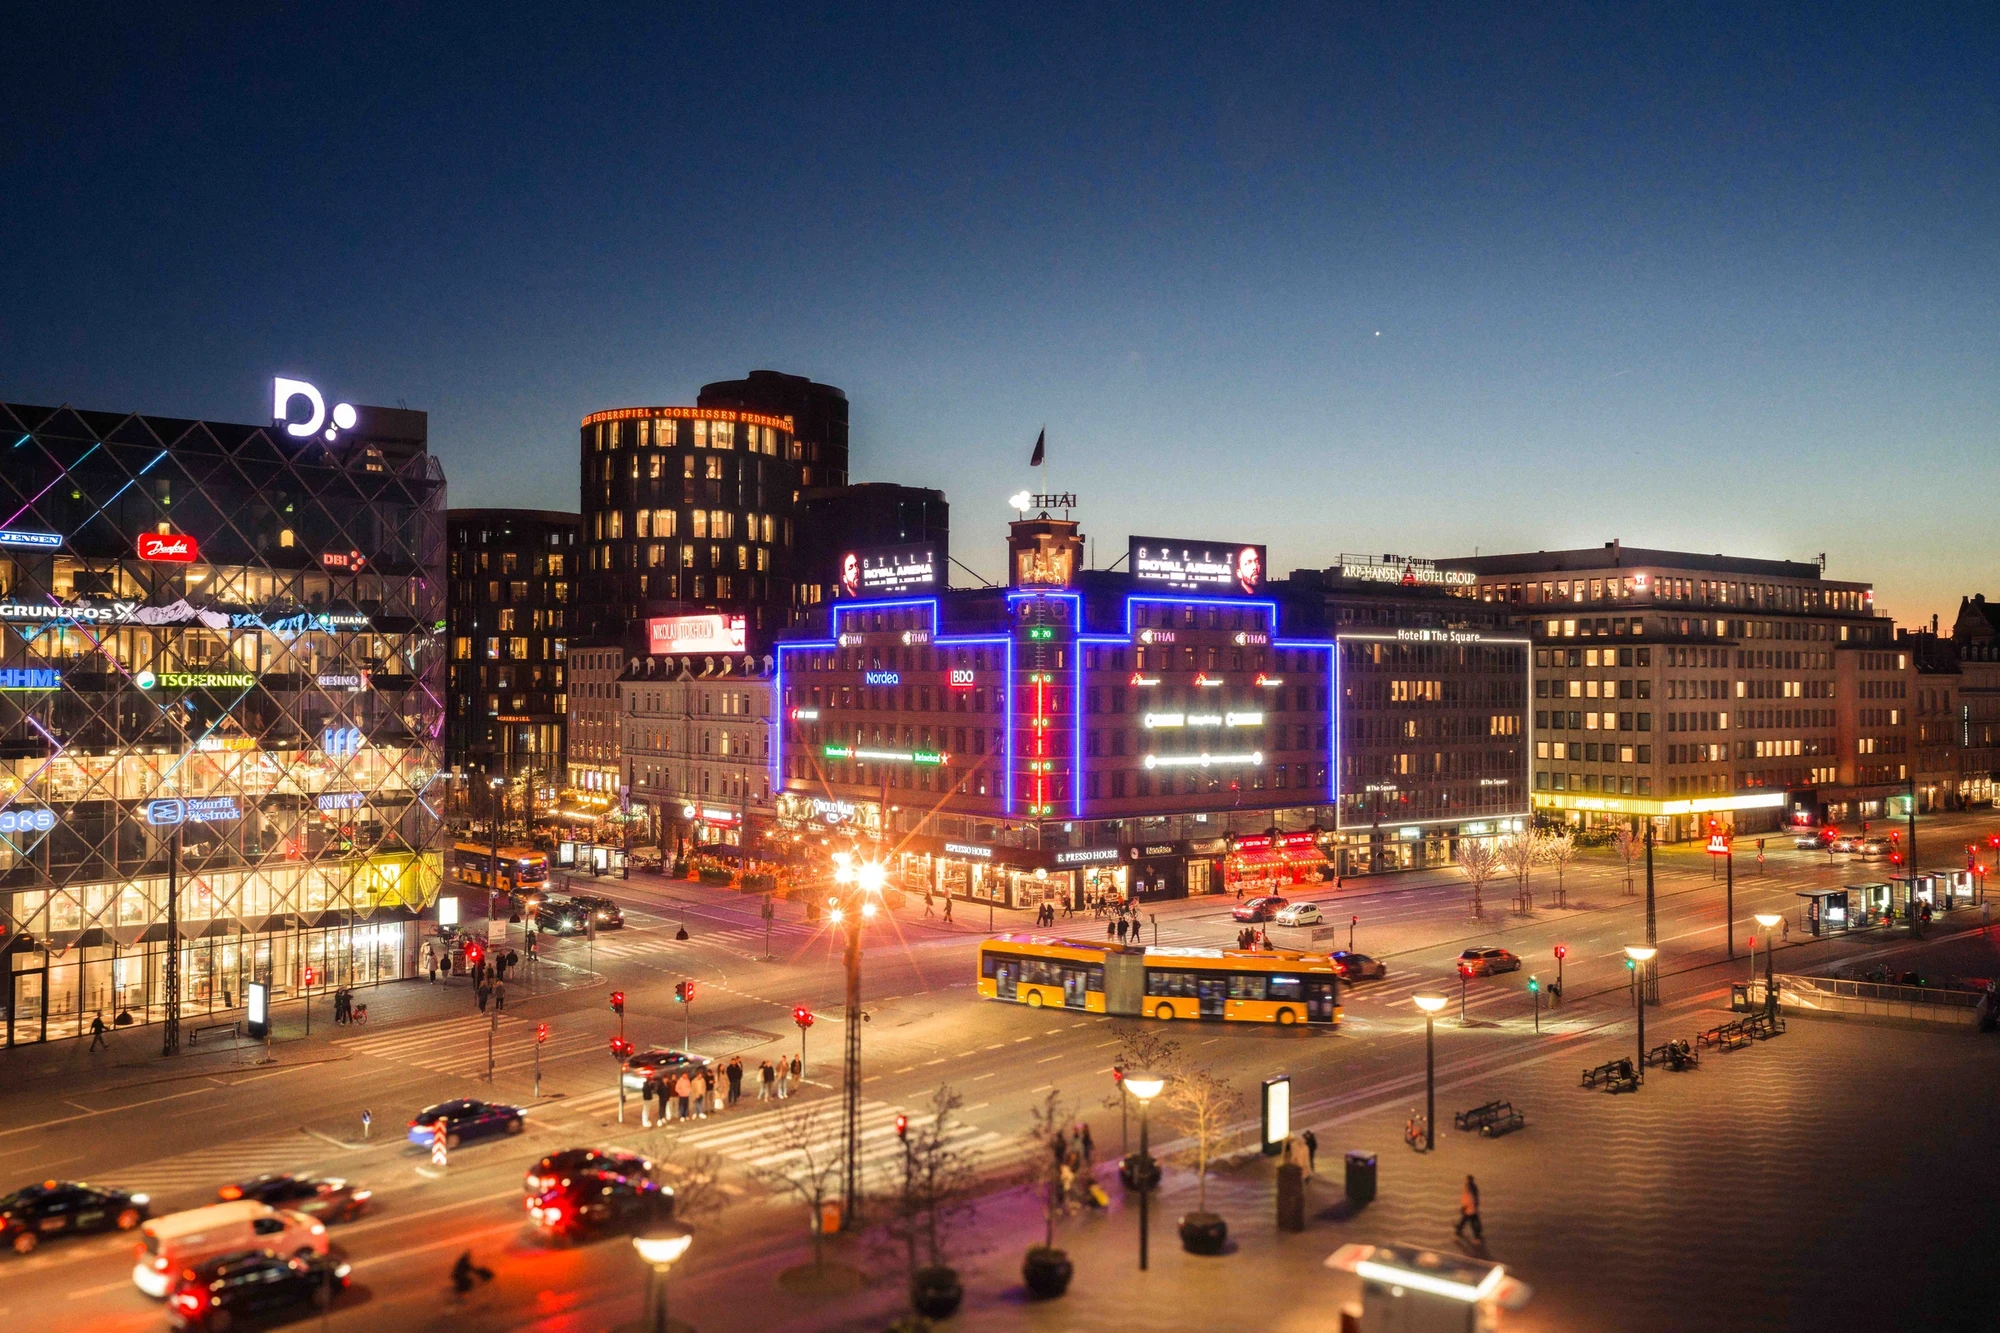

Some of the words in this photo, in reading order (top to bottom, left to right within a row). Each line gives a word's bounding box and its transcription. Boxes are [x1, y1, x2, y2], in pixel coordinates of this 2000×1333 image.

[593, 408, 651, 422] FEDERSPIEL
[664, 408, 736, 420] GORRISSEN
[741, 412, 790, 431] FEDERSPIEL
[1032, 494, 1077, 508] THAI
[1, 533, 59, 543] JENSEN
[146, 540, 188, 556] Danfoss
[323, 553, 348, 566] DBI
[1391, 555, 1406, 564] The
[1408, 556, 1435, 567] Square
[1343, 566, 1401, 582] ARP-HANSEN
[1416, 570, 1444, 583] HOTEL
[1445, 572, 1476, 584] GROUP
[0, 604, 112, 619] GRUNDFOS
[330, 616, 369, 624] JULIANA
[847, 635, 862, 645] THAI
[911, 632, 928, 643] THAI
[1152, 632, 1175, 642] THAI
[1246, 634, 1266, 644] THAI
[1398, 629, 1423, 641] Hotel
[1431, 630, 1448, 641] The
[1450, 631, 1480, 644] Square
[158, 674, 254, 687] TSCHERNING
[866, 671, 899, 684] Nordea
[953, 670, 973, 683] BDO
[914, 752, 941, 763] Heineken
[188, 797, 233, 809] Smurfit
[318, 794, 364, 809] NKT
[2, 814, 50, 828] JKS
[188, 808, 240, 821] Westrock
[1093, 849, 1118, 860] HOUSE
